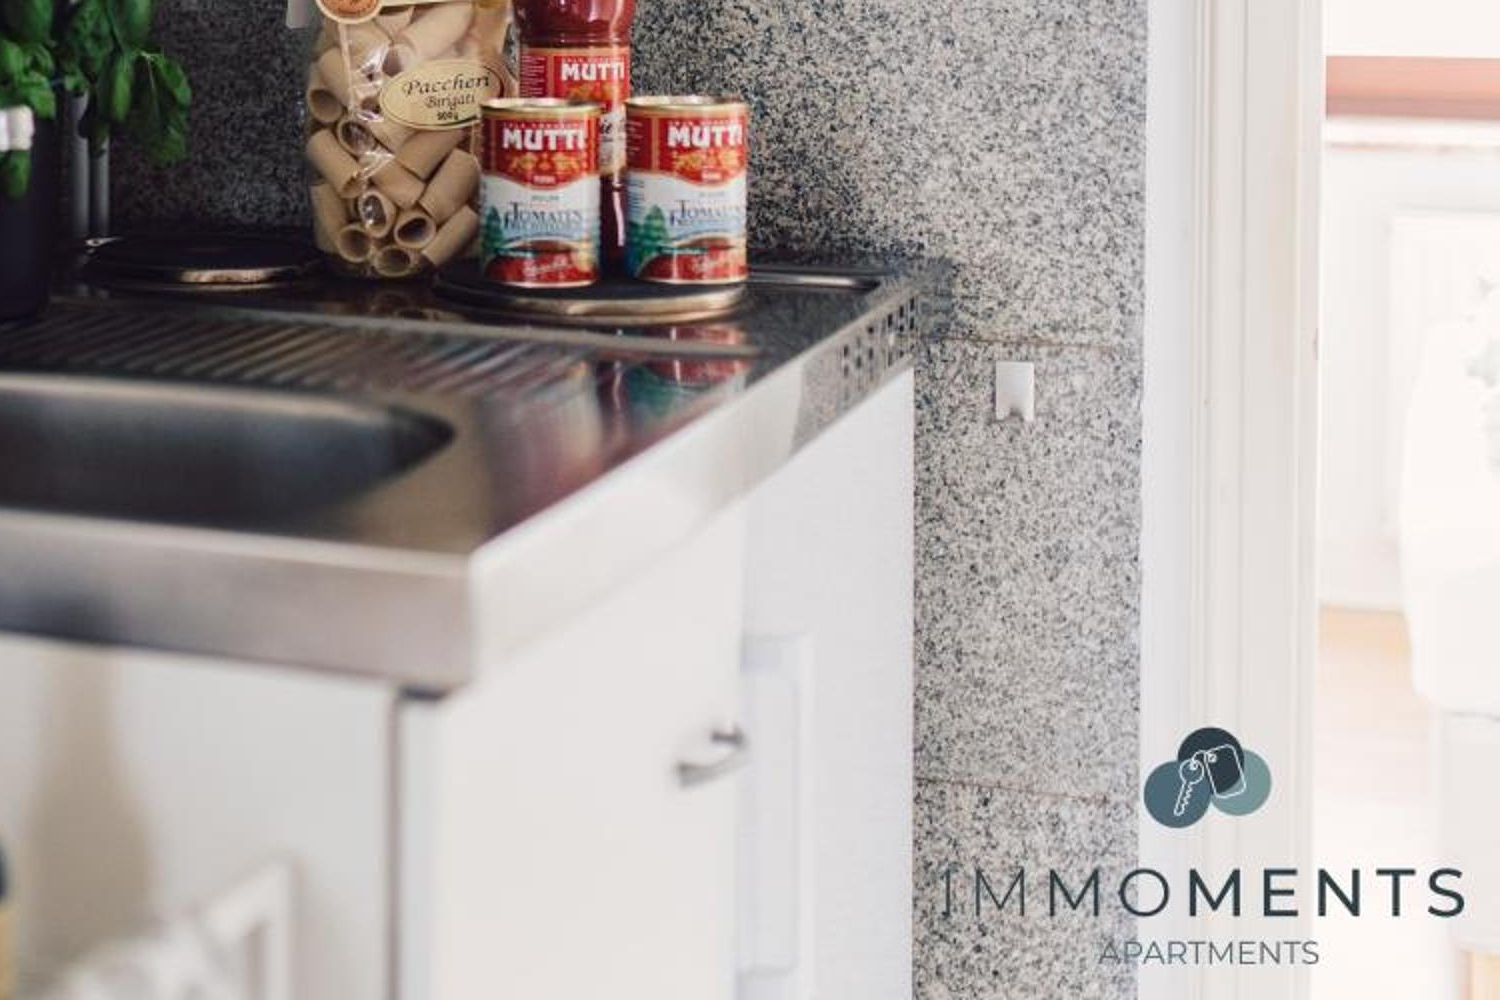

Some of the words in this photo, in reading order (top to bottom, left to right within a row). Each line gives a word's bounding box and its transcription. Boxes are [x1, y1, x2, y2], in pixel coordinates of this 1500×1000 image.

[561, 61, 625, 81] MUTTI
[503, 128, 587, 151] MUTTI
[667, 124, 742, 149] MUTTI
